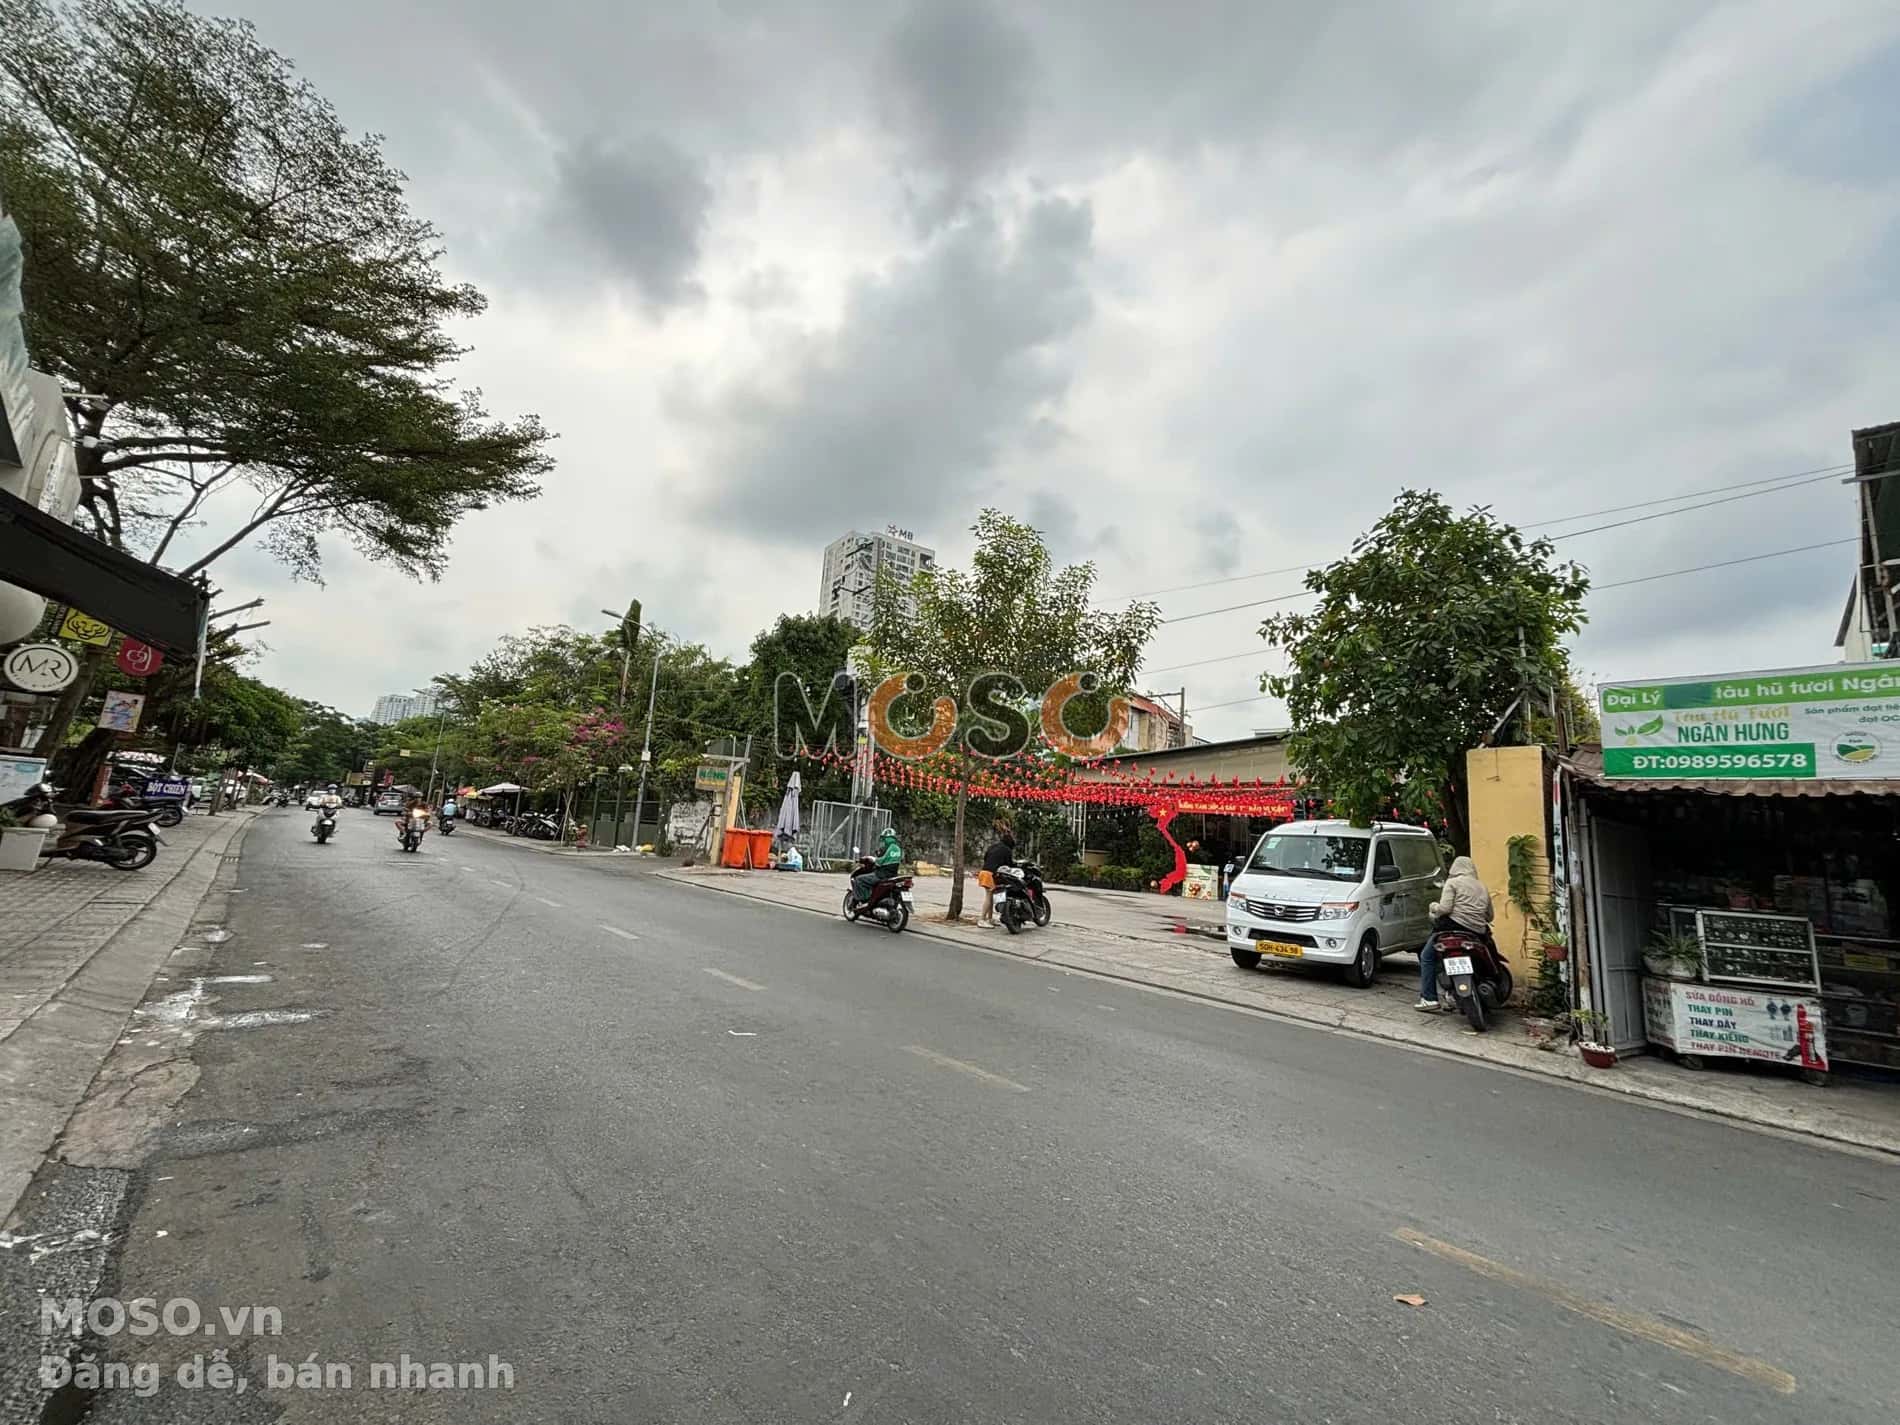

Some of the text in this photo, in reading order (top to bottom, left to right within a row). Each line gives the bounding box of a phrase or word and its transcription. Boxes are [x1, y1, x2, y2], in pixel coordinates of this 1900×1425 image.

[899, 528, 914, 540] MB
[17, 654, 62, 679] MR
[1607, 693, 1636, 708] Đại
[1642, 690, 1661, 705] Lý
[1715, 686, 1750, 699] tàu
[1791, 679, 1834, 695] tươi
[1678, 722, 1789, 743] NGÂN HƯNG
[1632, 753, 1807, 769] ĐT:0989596578
[147, 781, 163, 796] BỘT
[1688, 1004, 1733, 1017] THAY PIN
[1689, 1017, 1714, 1028] THAY
[1690, 1029, 1714, 1040] THAY
[1691, 1042, 1715, 1052] THAY
